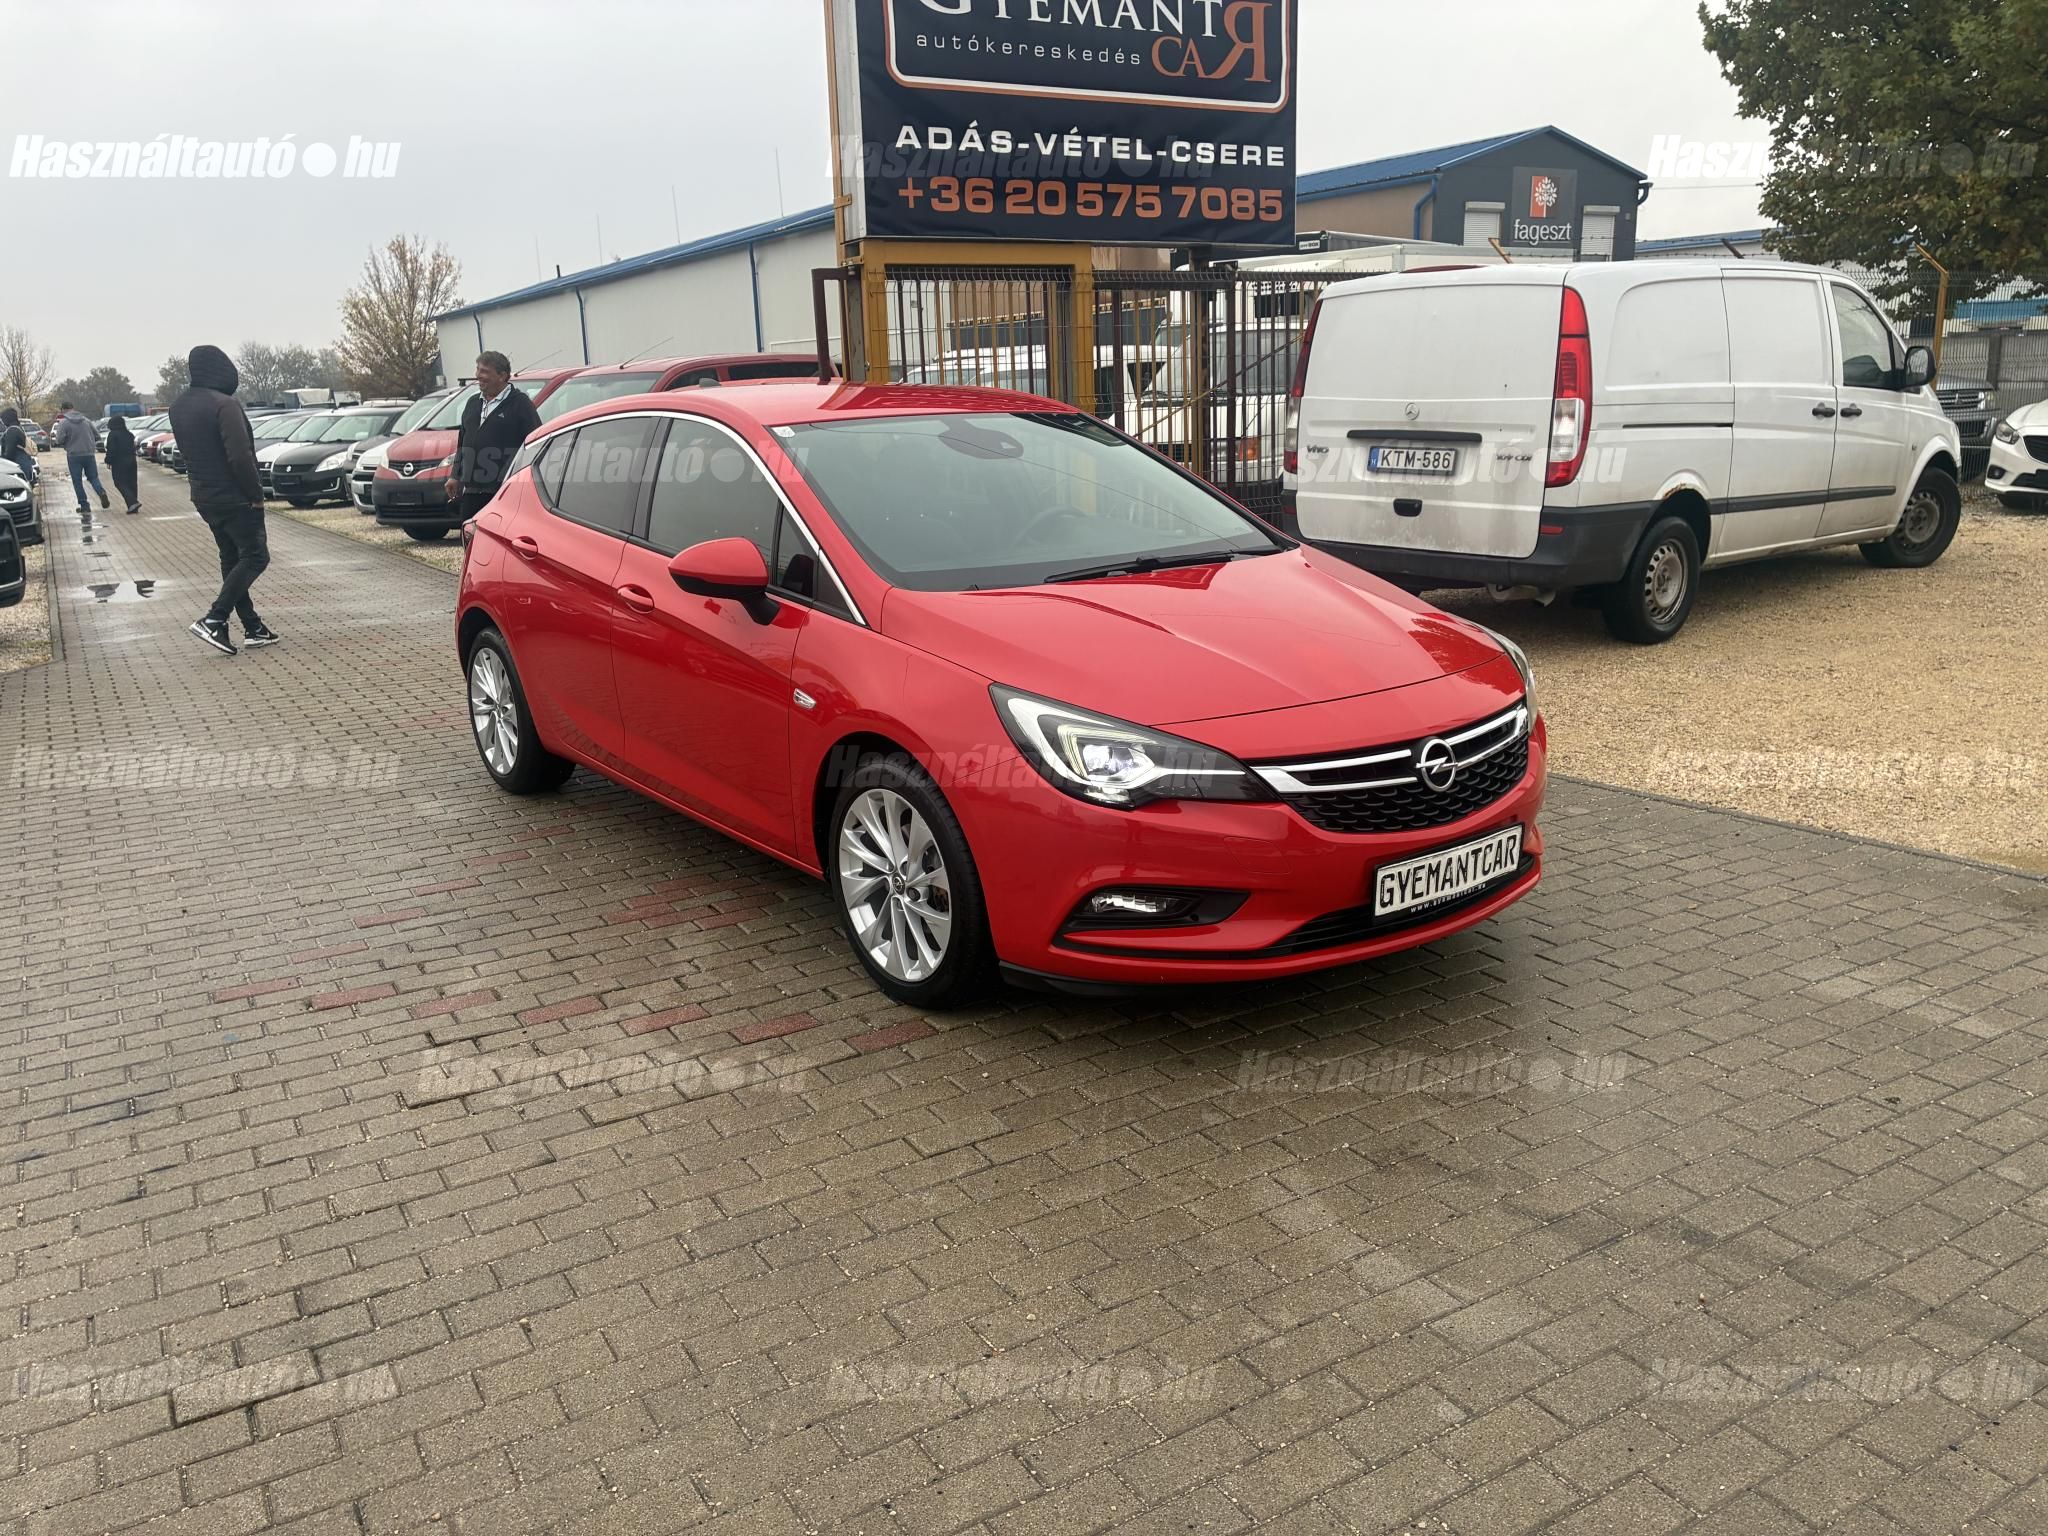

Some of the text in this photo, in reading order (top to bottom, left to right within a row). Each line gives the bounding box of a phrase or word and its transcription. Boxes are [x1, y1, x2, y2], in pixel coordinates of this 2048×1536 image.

[916, 33, 1141, 65] autókereskedés
[895, 120, 1285, 167] ADÁS-VÉTEL-CSERE
[898, 177, 1284, 222] +36 20 575 7085
[1514, 218, 1573, 246] fageszt
[1380, 449, 1452, 469] KTM-586
[1379, 834, 1517, 909] GYEMANTCAR
